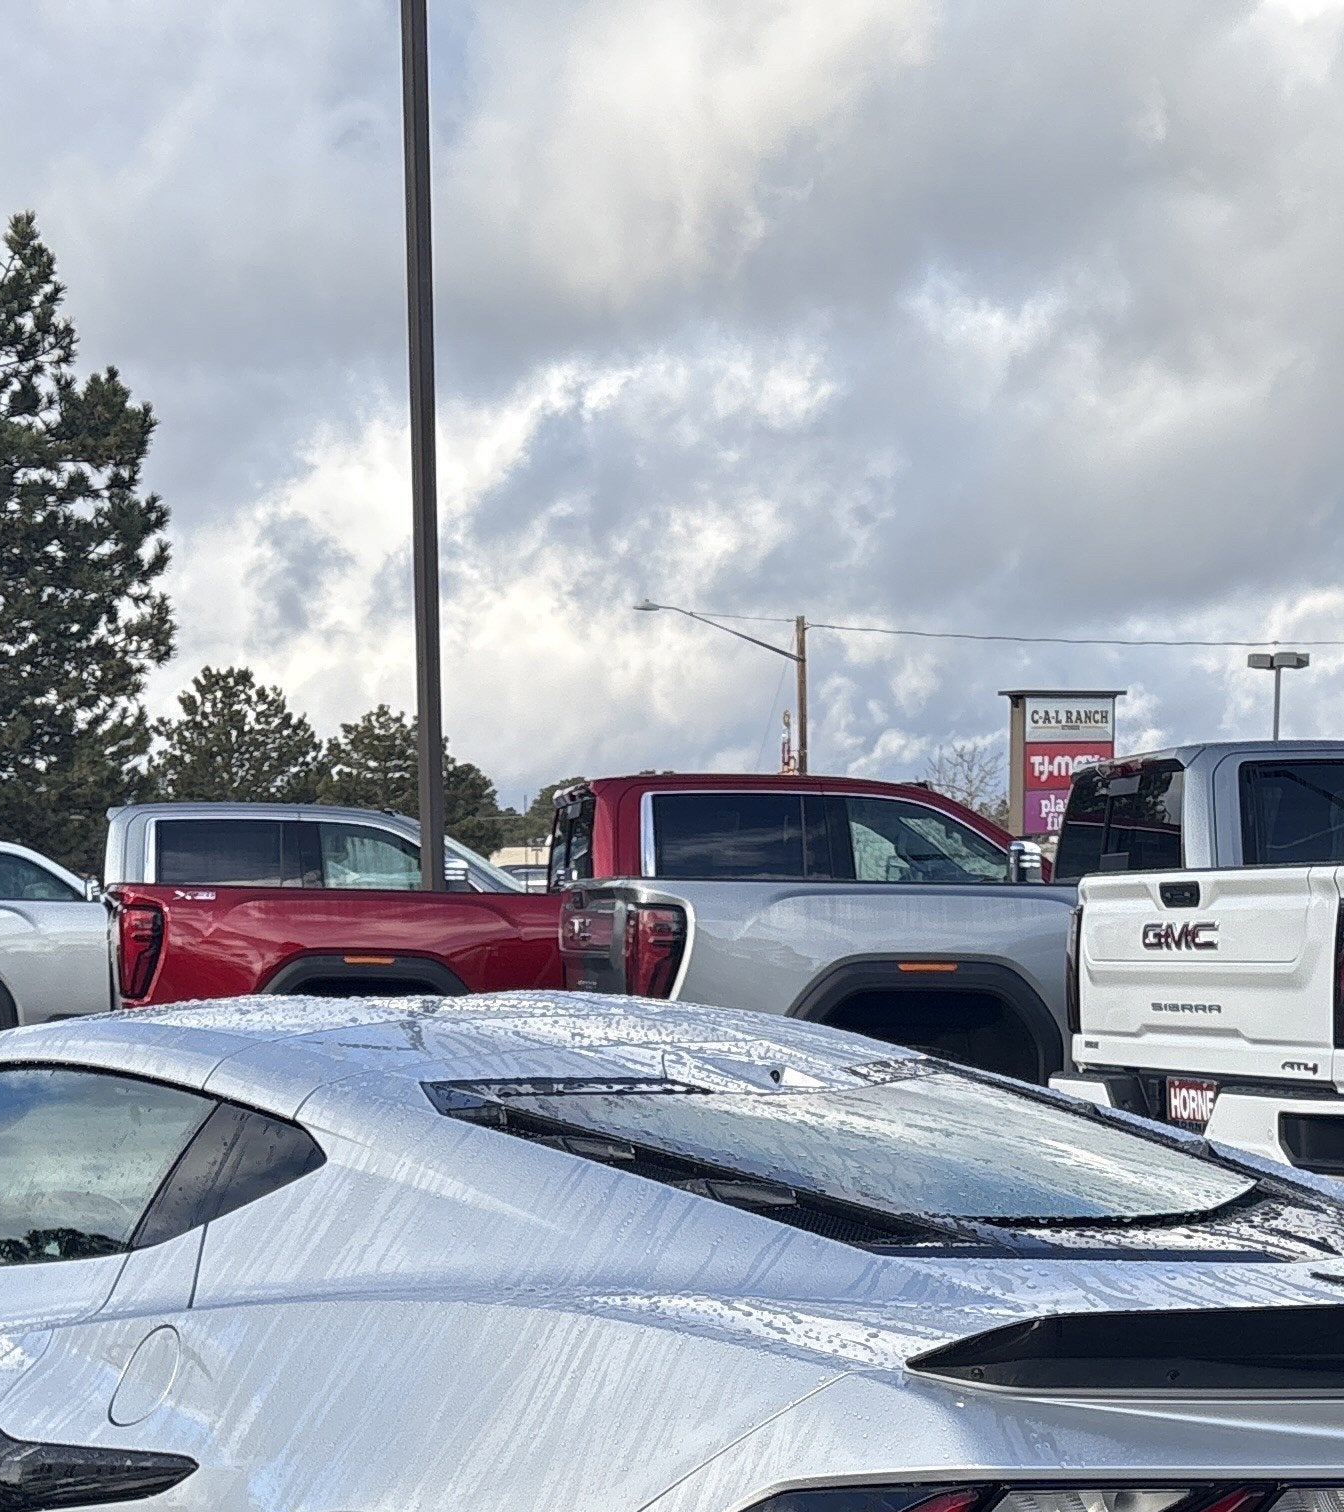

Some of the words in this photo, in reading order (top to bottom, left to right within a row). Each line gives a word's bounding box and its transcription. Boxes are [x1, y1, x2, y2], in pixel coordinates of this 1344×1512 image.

[1065, 709, 1109, 724] RANCH
[1142, 920, 1220, 950] GMC
[1150, 1002, 1222, 1014] SIERRA
[1280, 1060, 1319, 1075] AT4
[1169, 1087, 1215, 1121] HORNE
